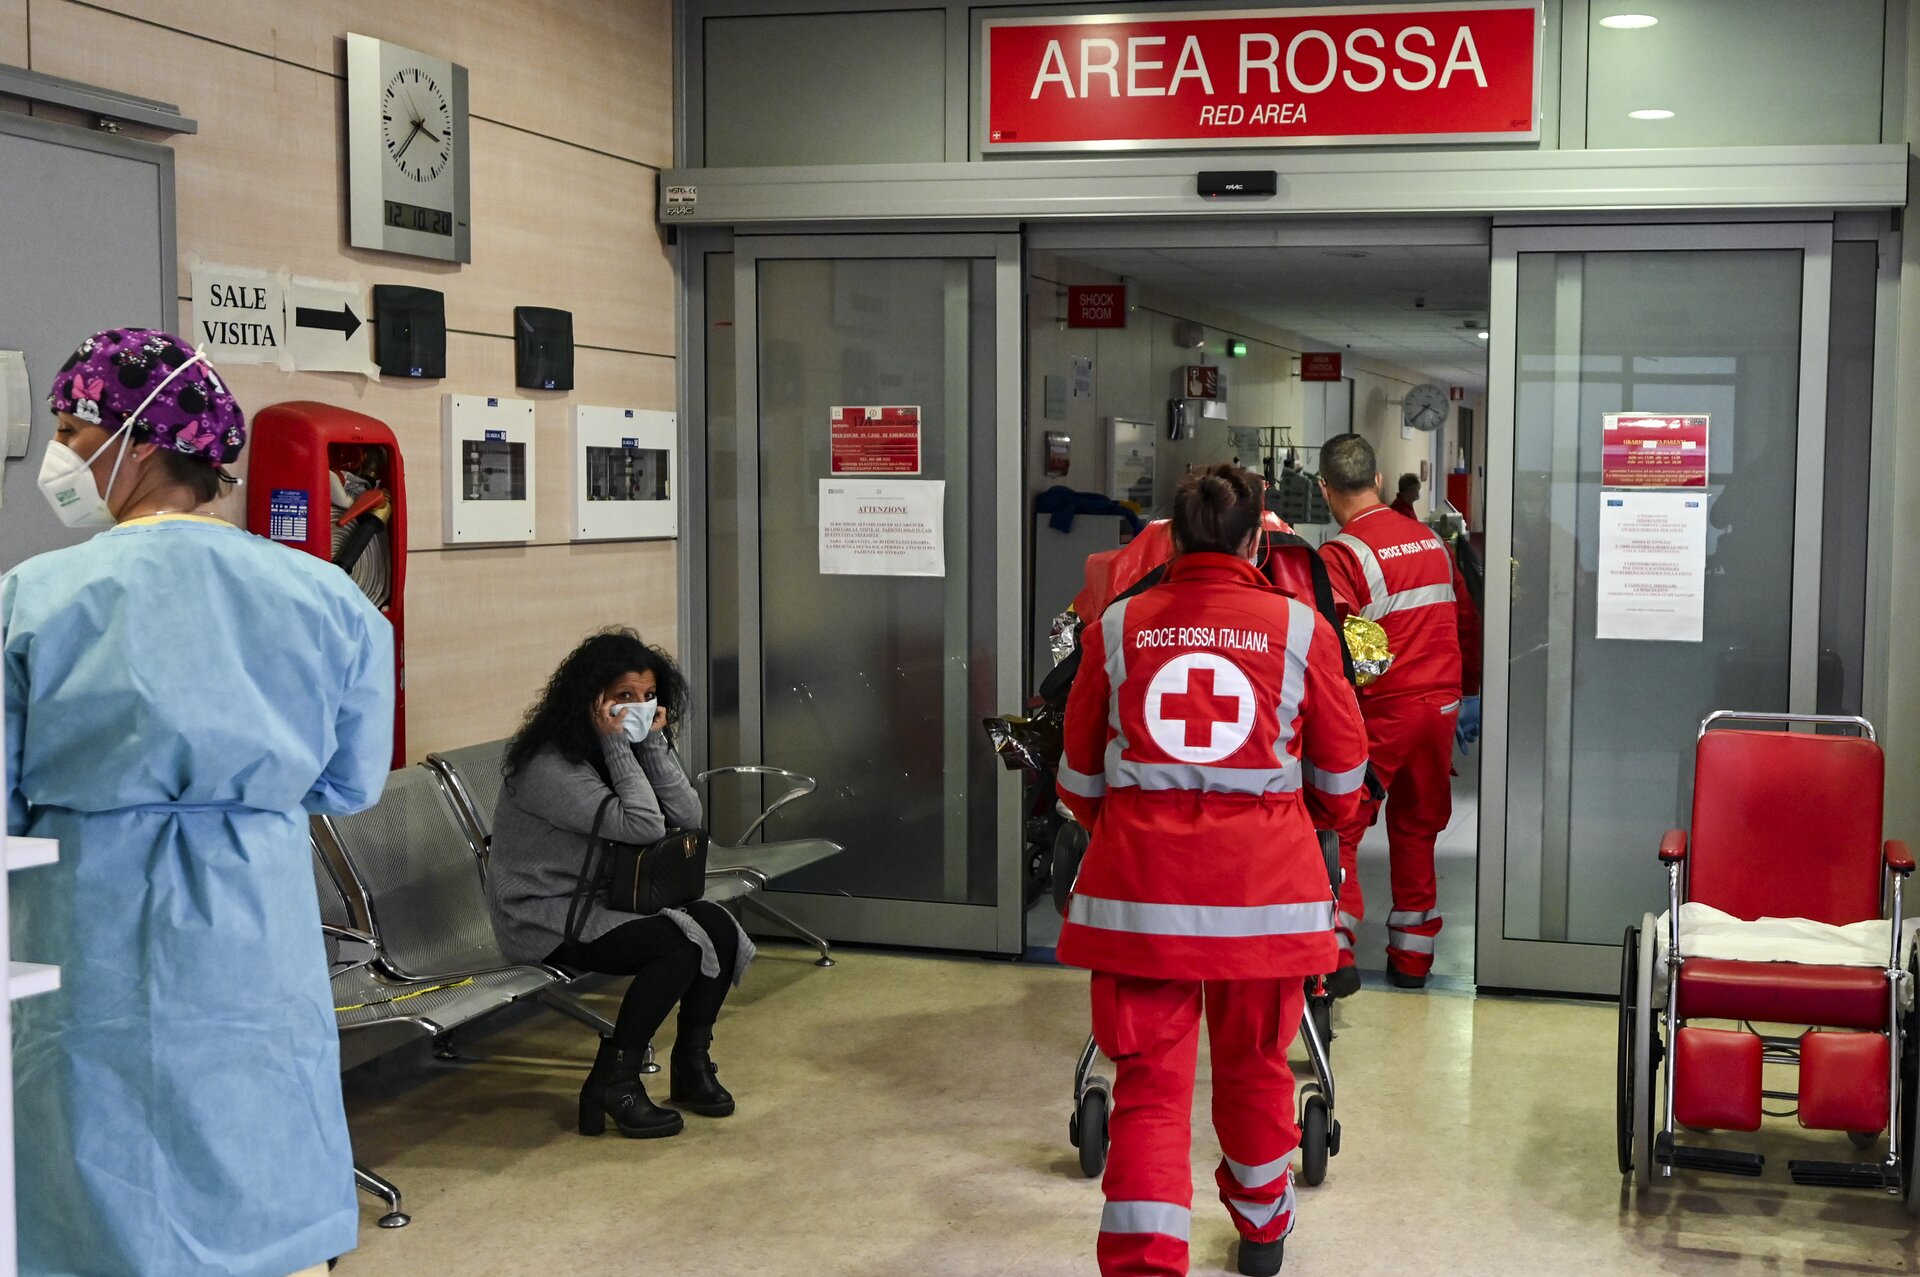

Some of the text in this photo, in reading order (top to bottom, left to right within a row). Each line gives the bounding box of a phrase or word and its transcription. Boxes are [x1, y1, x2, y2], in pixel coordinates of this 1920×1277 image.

[1030, 26, 1489, 99] AREA ROSSA
[1199, 103, 1307, 125] RED AREA
[666, 206, 694, 216] FAAC
[210, 283, 267, 310] SALE
[1080, 293, 1114, 306] SHOCK
[1082, 307, 1112, 320] ROOM
[202, 320, 277, 347] VISITA
[858, 506, 908, 514] ATTENZIONE
[1378, 545, 1402, 560] CROCE
[1400, 541, 1424, 555] ROSSA
[1136, 627, 1269, 653] CROCE ROSSA ITALIANA
